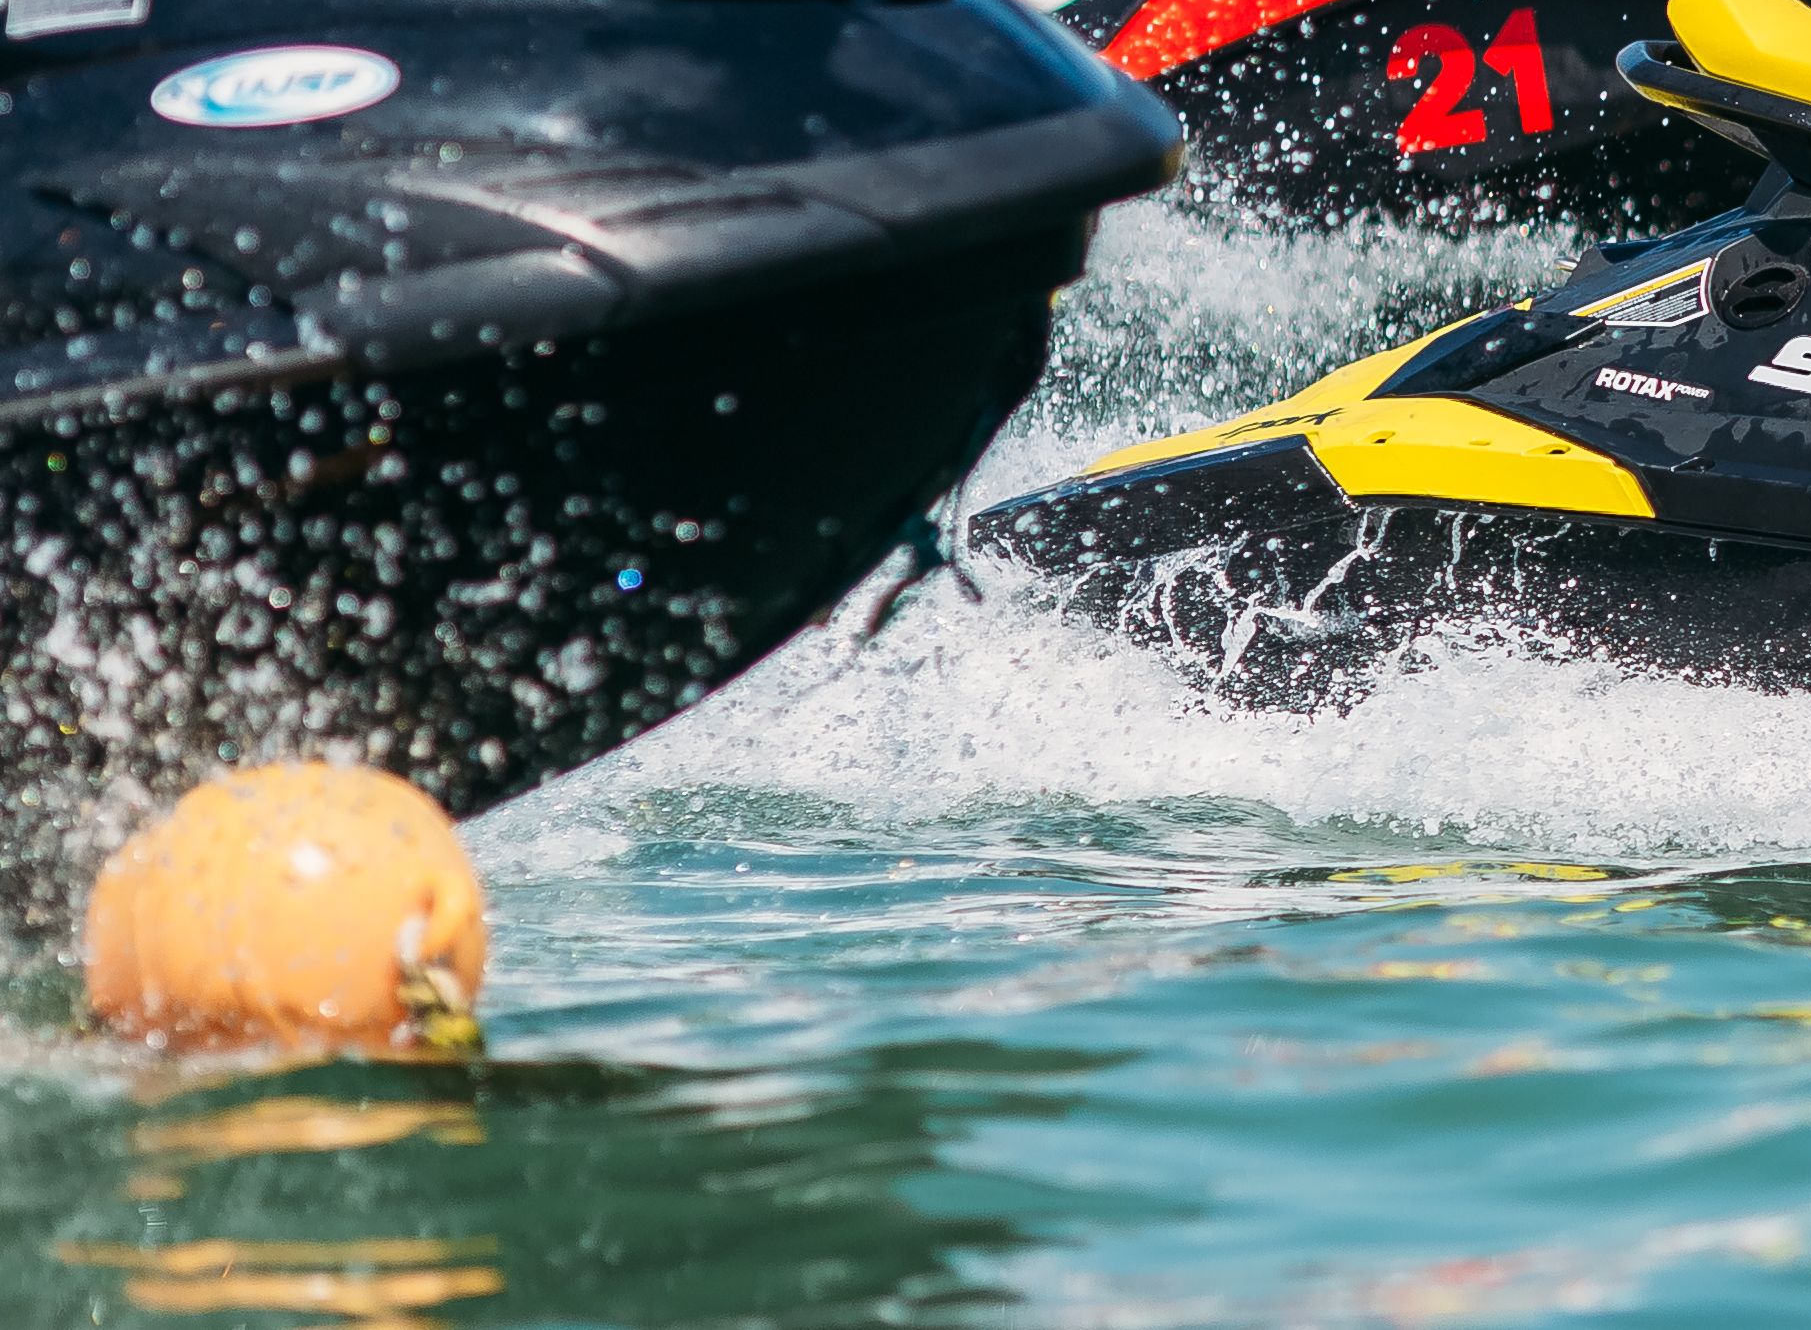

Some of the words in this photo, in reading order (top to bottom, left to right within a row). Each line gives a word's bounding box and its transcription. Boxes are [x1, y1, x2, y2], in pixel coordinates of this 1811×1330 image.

[1387, 6, 1554, 154] 21
[1595, 367, 1678, 402] ROTAX
[1675, 383, 1710, 399] POWER
